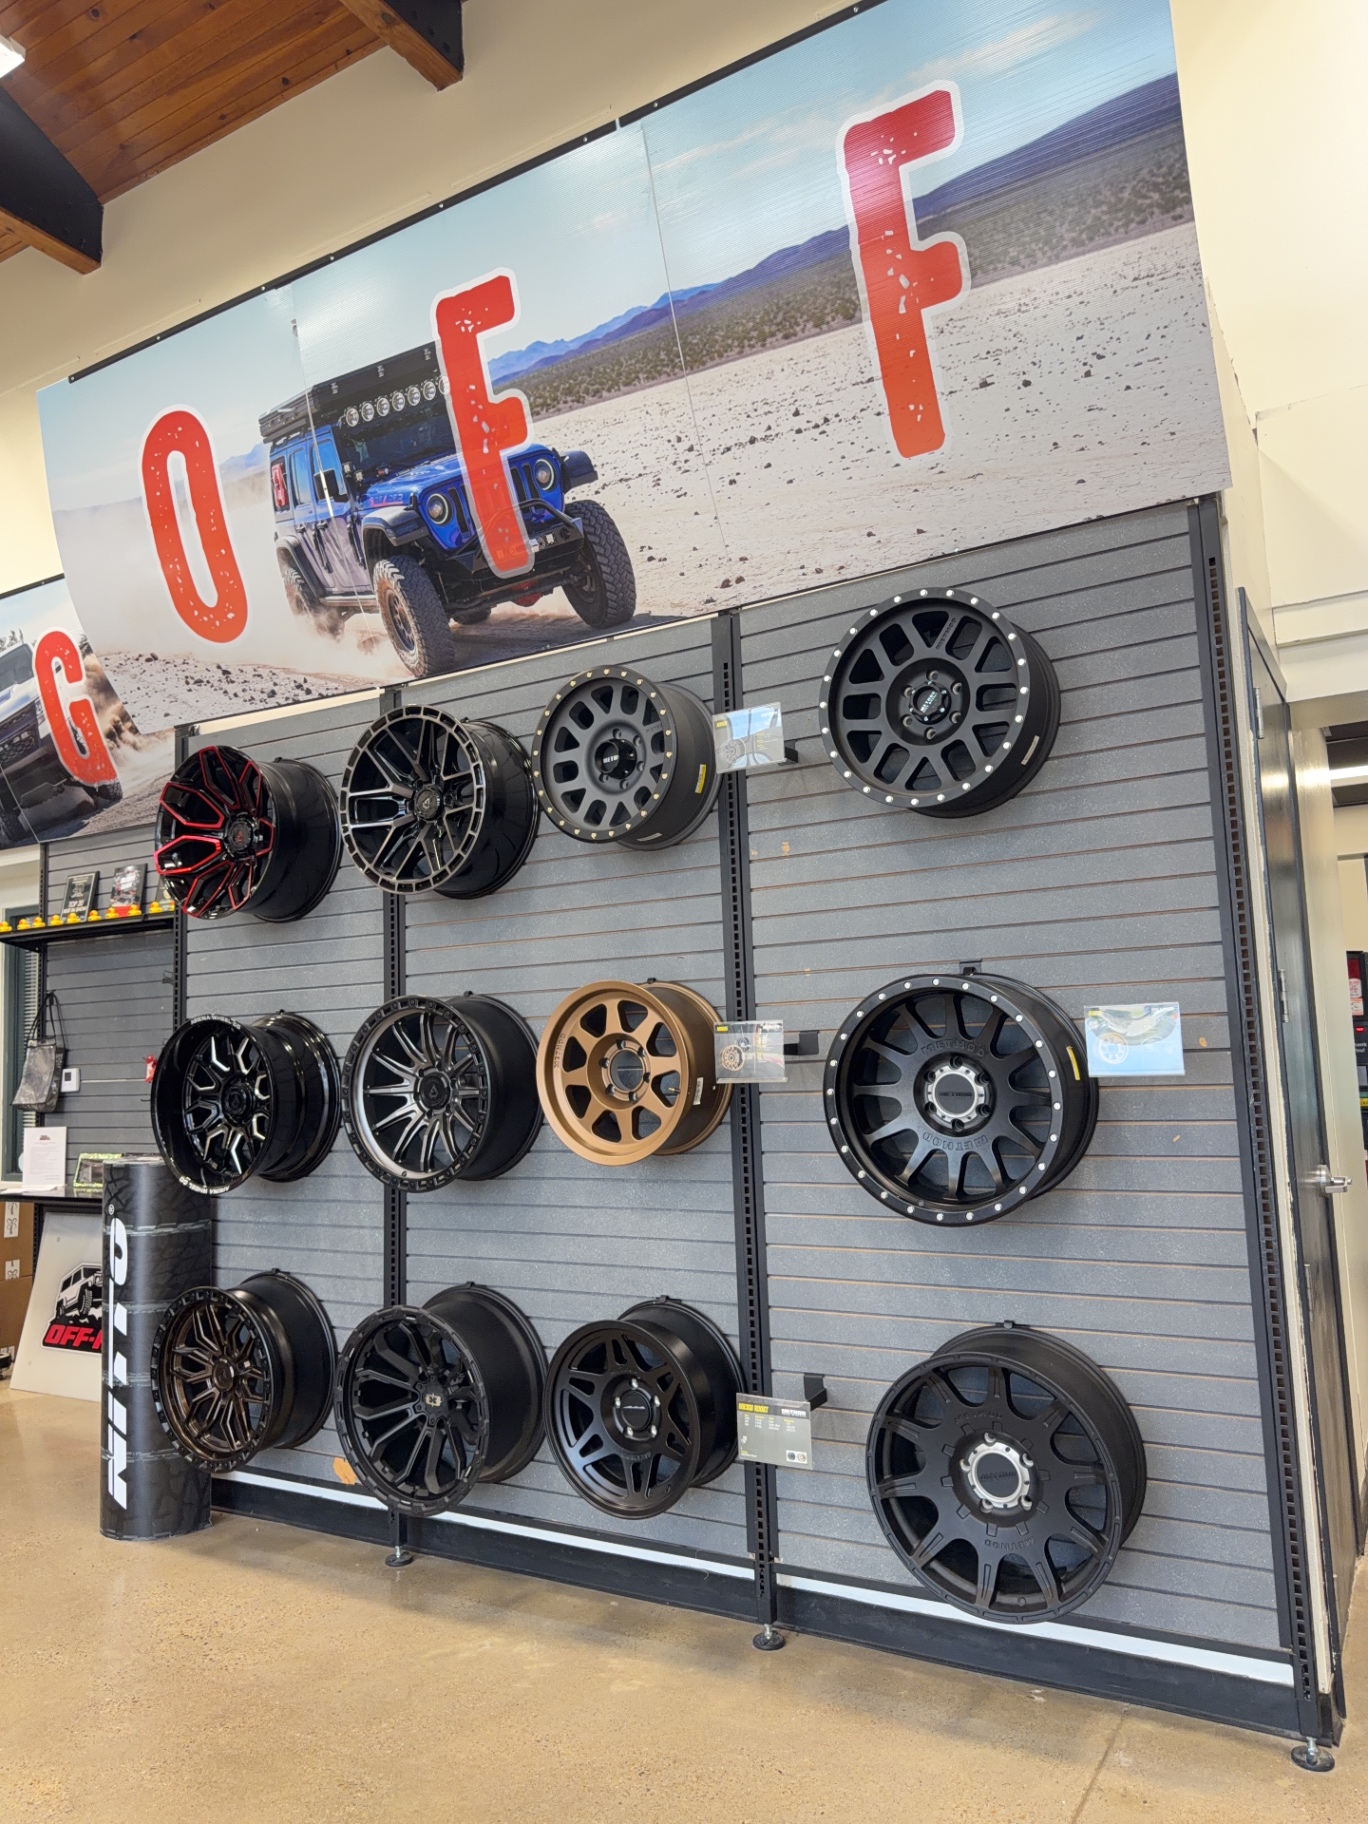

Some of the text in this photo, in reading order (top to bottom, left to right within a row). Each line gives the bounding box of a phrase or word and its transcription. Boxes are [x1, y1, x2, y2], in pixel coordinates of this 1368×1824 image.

[34, 631, 119, 785] G
[921, 1039, 985, 1056] METHOD
[923, 1131, 989, 1151] METHOD
[984, 1536, 1035, 1550] METHOD
